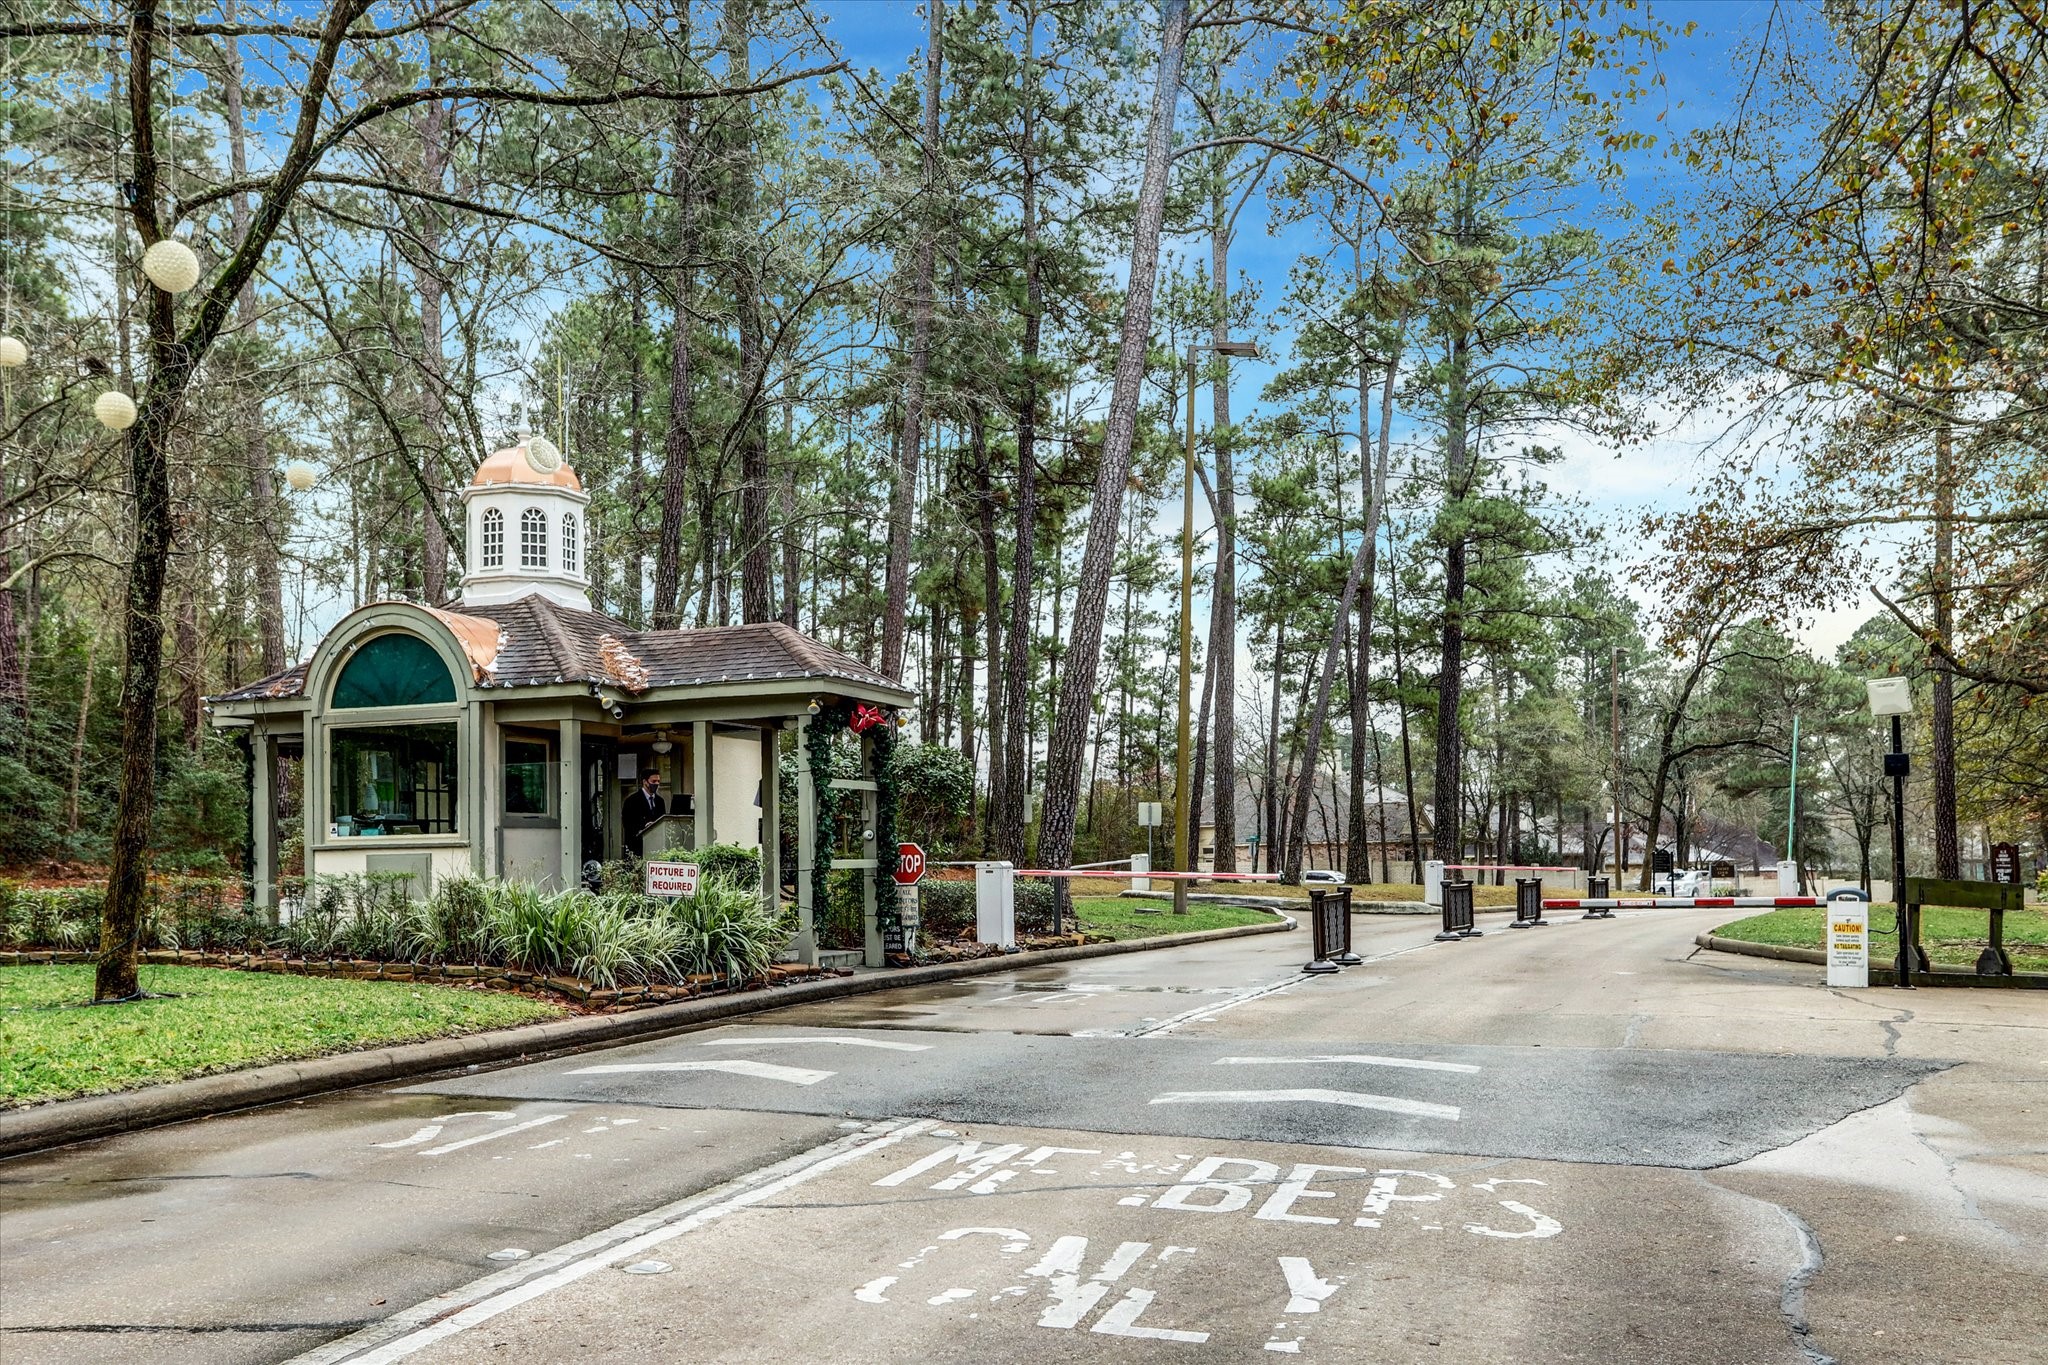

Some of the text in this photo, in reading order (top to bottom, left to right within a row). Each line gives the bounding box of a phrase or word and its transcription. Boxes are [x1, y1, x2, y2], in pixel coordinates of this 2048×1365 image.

[897, 854, 921, 873] TOP
[650, 867, 696, 878] PICTURE ID
[652, 881, 693, 892] REQUIRED
[1834, 924, 1862, 932] CAUTION!
